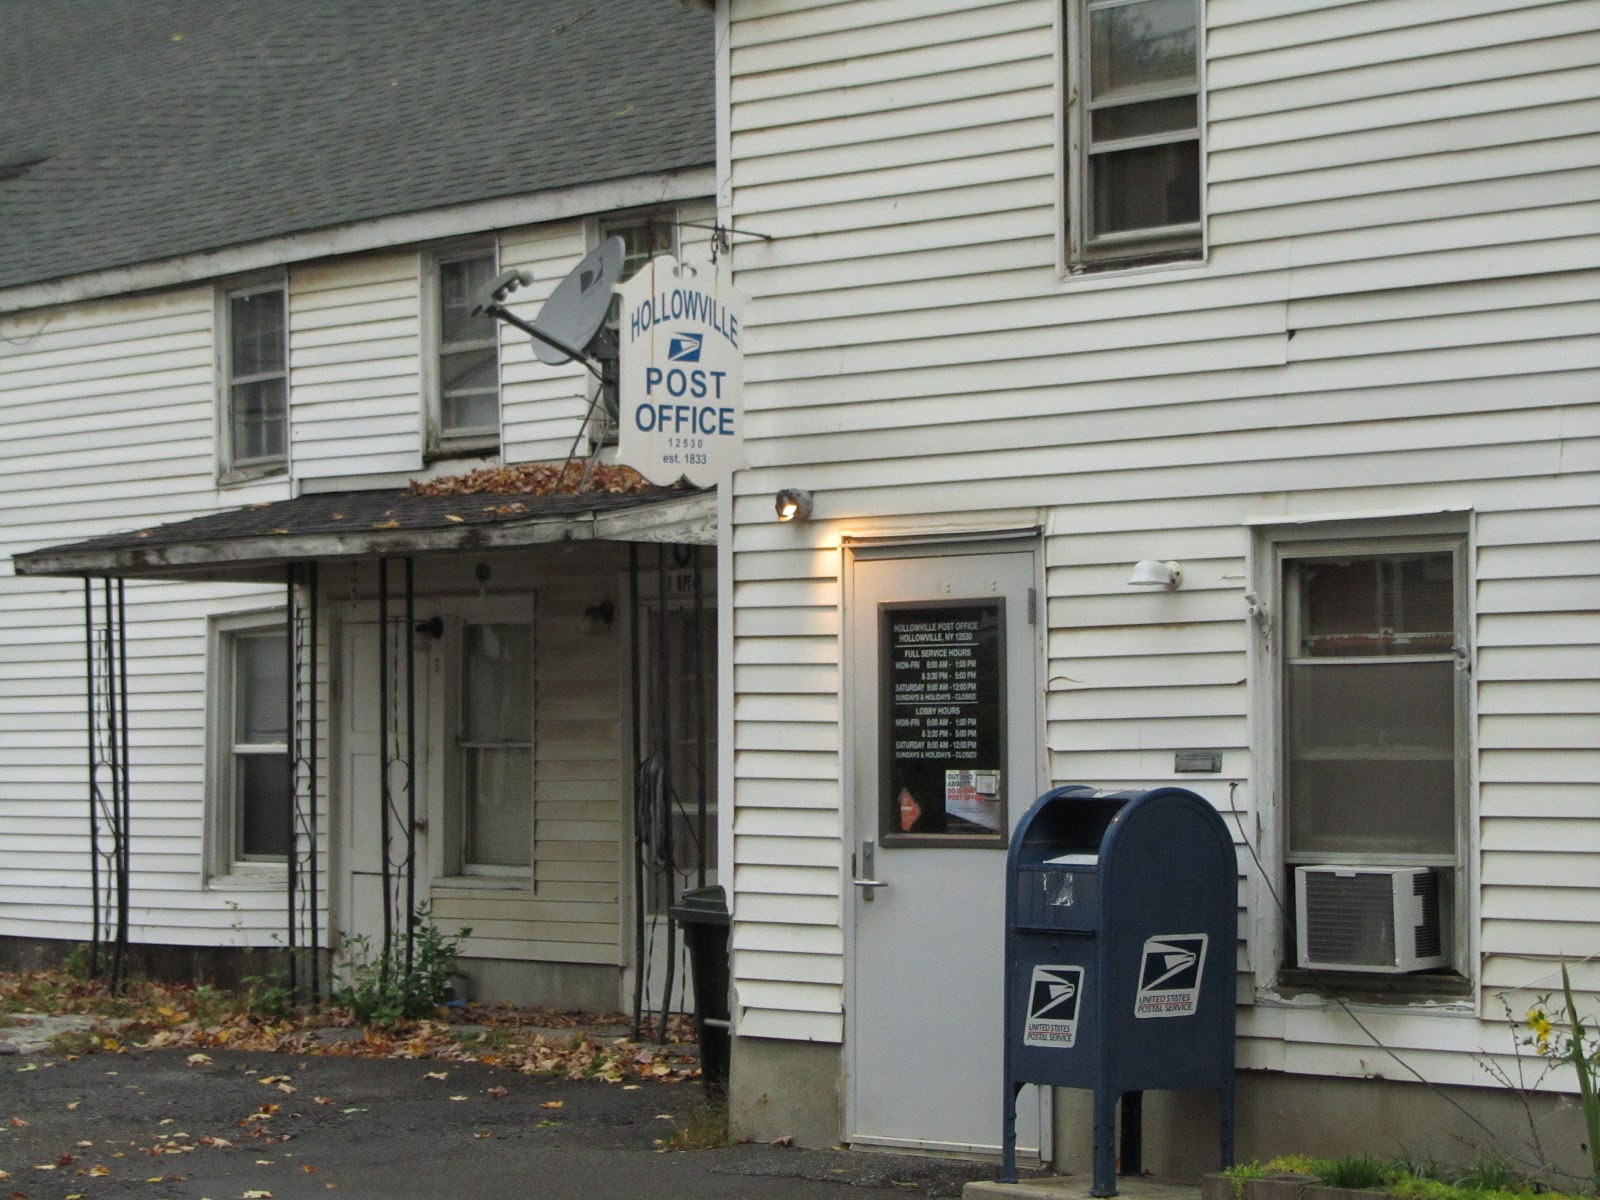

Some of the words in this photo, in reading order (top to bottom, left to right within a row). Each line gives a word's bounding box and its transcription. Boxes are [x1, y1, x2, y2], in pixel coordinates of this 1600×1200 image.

[631, 289, 738, 349] HOLLOWVILLE
[646, 367, 726, 399] POST
[635, 403, 735, 436] OFFICE
[668, 438, 703, 449] 12530
[663, 454, 681, 464] est.
[685, 454, 707, 464] 1833
[894, 623, 937, 632] HOLLOWVILLE
[938, 622, 954, 631] POST
[955, 622, 978, 630] OFFICE
[899, 633, 944, 642] HOLLOWVILLE,
[945, 633, 954, 641] NY
[955, 633, 973, 641] 12530
[904, 650, 920, 658] FULL
[921, 649, 947, 657] SERVICE
[948, 649, 971, 657] HOURS
[895, 661, 920, 669] MON-FRI
[955, 660, 966, 668] 1:00
[967, 660, 977, 668] PM
[955, 672, 966, 680] 5:00
[967, 671, 977, 679] PM
[895, 684, 925, 692] SATURDAY
[939, 683, 948, 691] AM
[952, 683, 967, 691] 12:00
[916, 707, 937, 715] LOBBY
[938, 707, 961, 715] HOURS
[895, 719, 920, 727] MON-FRI
[968, 718, 977, 726] PM
[939, 730, 948, 738] PM
[895, 741, 925, 749] SATURDAY
[939, 741, 948, 749] AM
[953, 741, 967, 749] 12:00
[1139, 995, 1166, 1003] UNITED
[1166, 993, 1191, 1002] STATES
[1138, 1005, 1163, 1013] POSTAL
[1164, 1003, 1192, 1011] SERVICE
[1050, 1024, 1071, 1032] STATES
[1027, 1033, 1048, 1041] POSTAL
[1048, 1034, 1072, 1042] SERVICE
